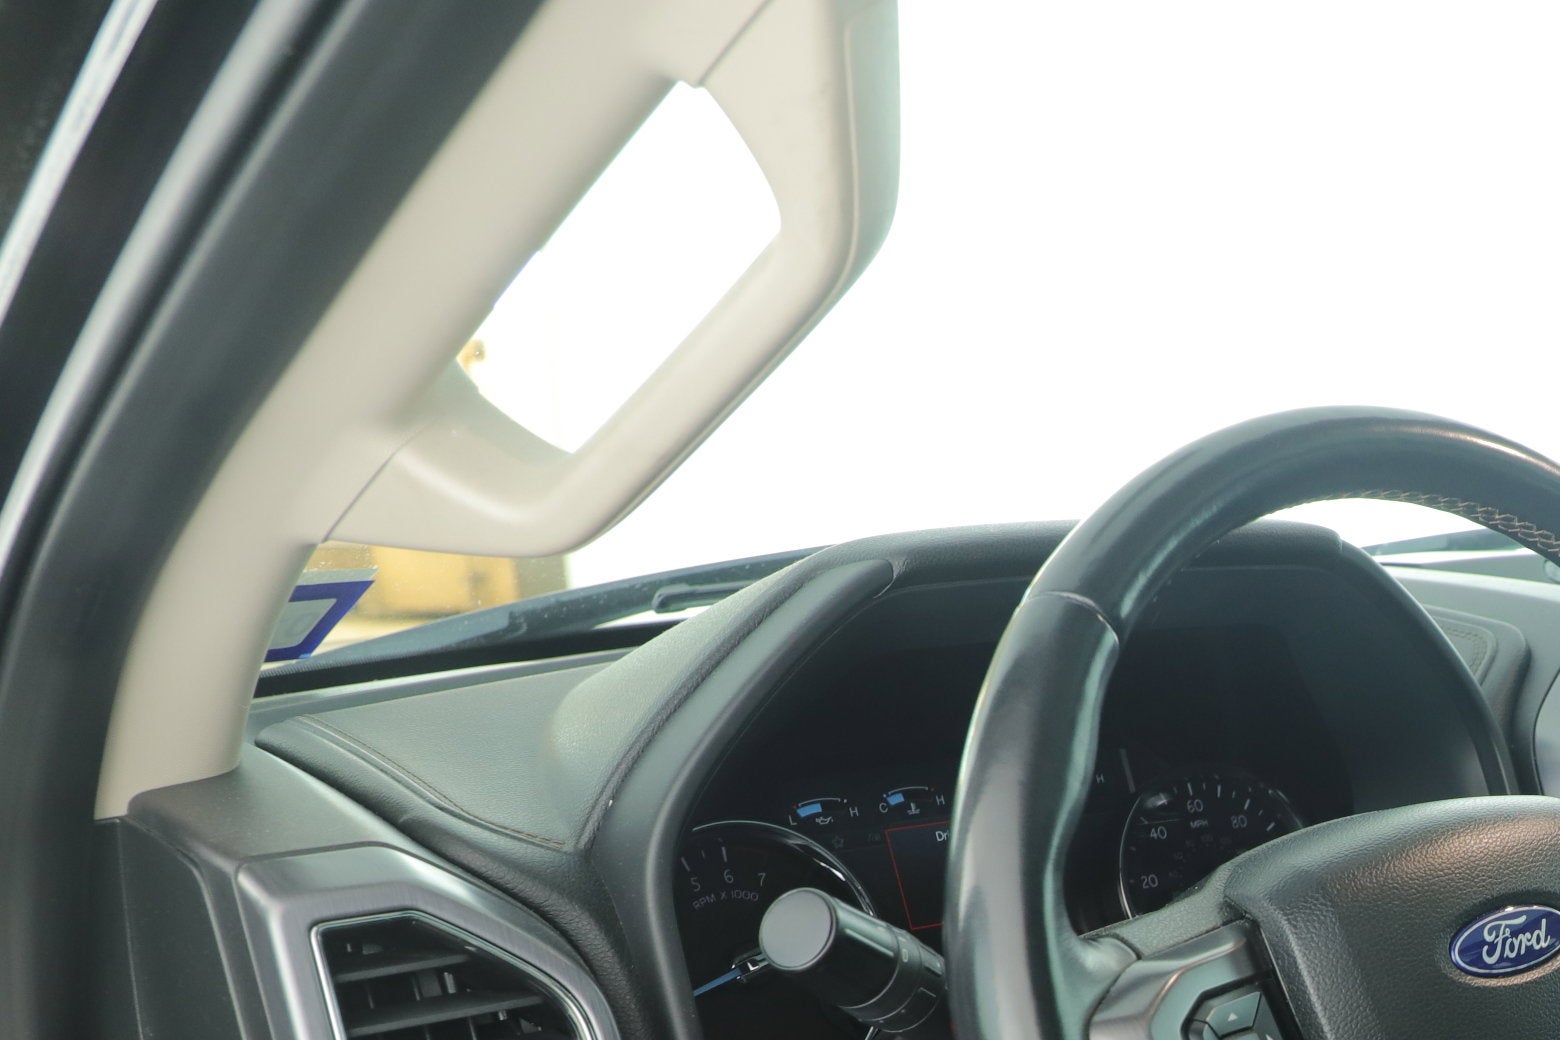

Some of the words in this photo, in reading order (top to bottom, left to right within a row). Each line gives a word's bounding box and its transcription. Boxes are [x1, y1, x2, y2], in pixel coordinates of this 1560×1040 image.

[878, 802, 888, 813] C
[935, 794, 946, 806] H
[1186, 798, 1204, 814] 60
[788, 815, 797, 826] L
[849, 806, 859, 818] H
[1230, 814, 1248, 829] 80
[1149, 826, 1168, 840] 40
[690, 876, 701, 892] 5
[723, 868, 734, 884] 6
[757, 872, 767, 887] 7
[1140, 874, 1159, 889] 20
[691, 893, 717, 911] RPM
[731, 889, 760, 902] 1000
[1481, 914, 1551, 966] Ford
